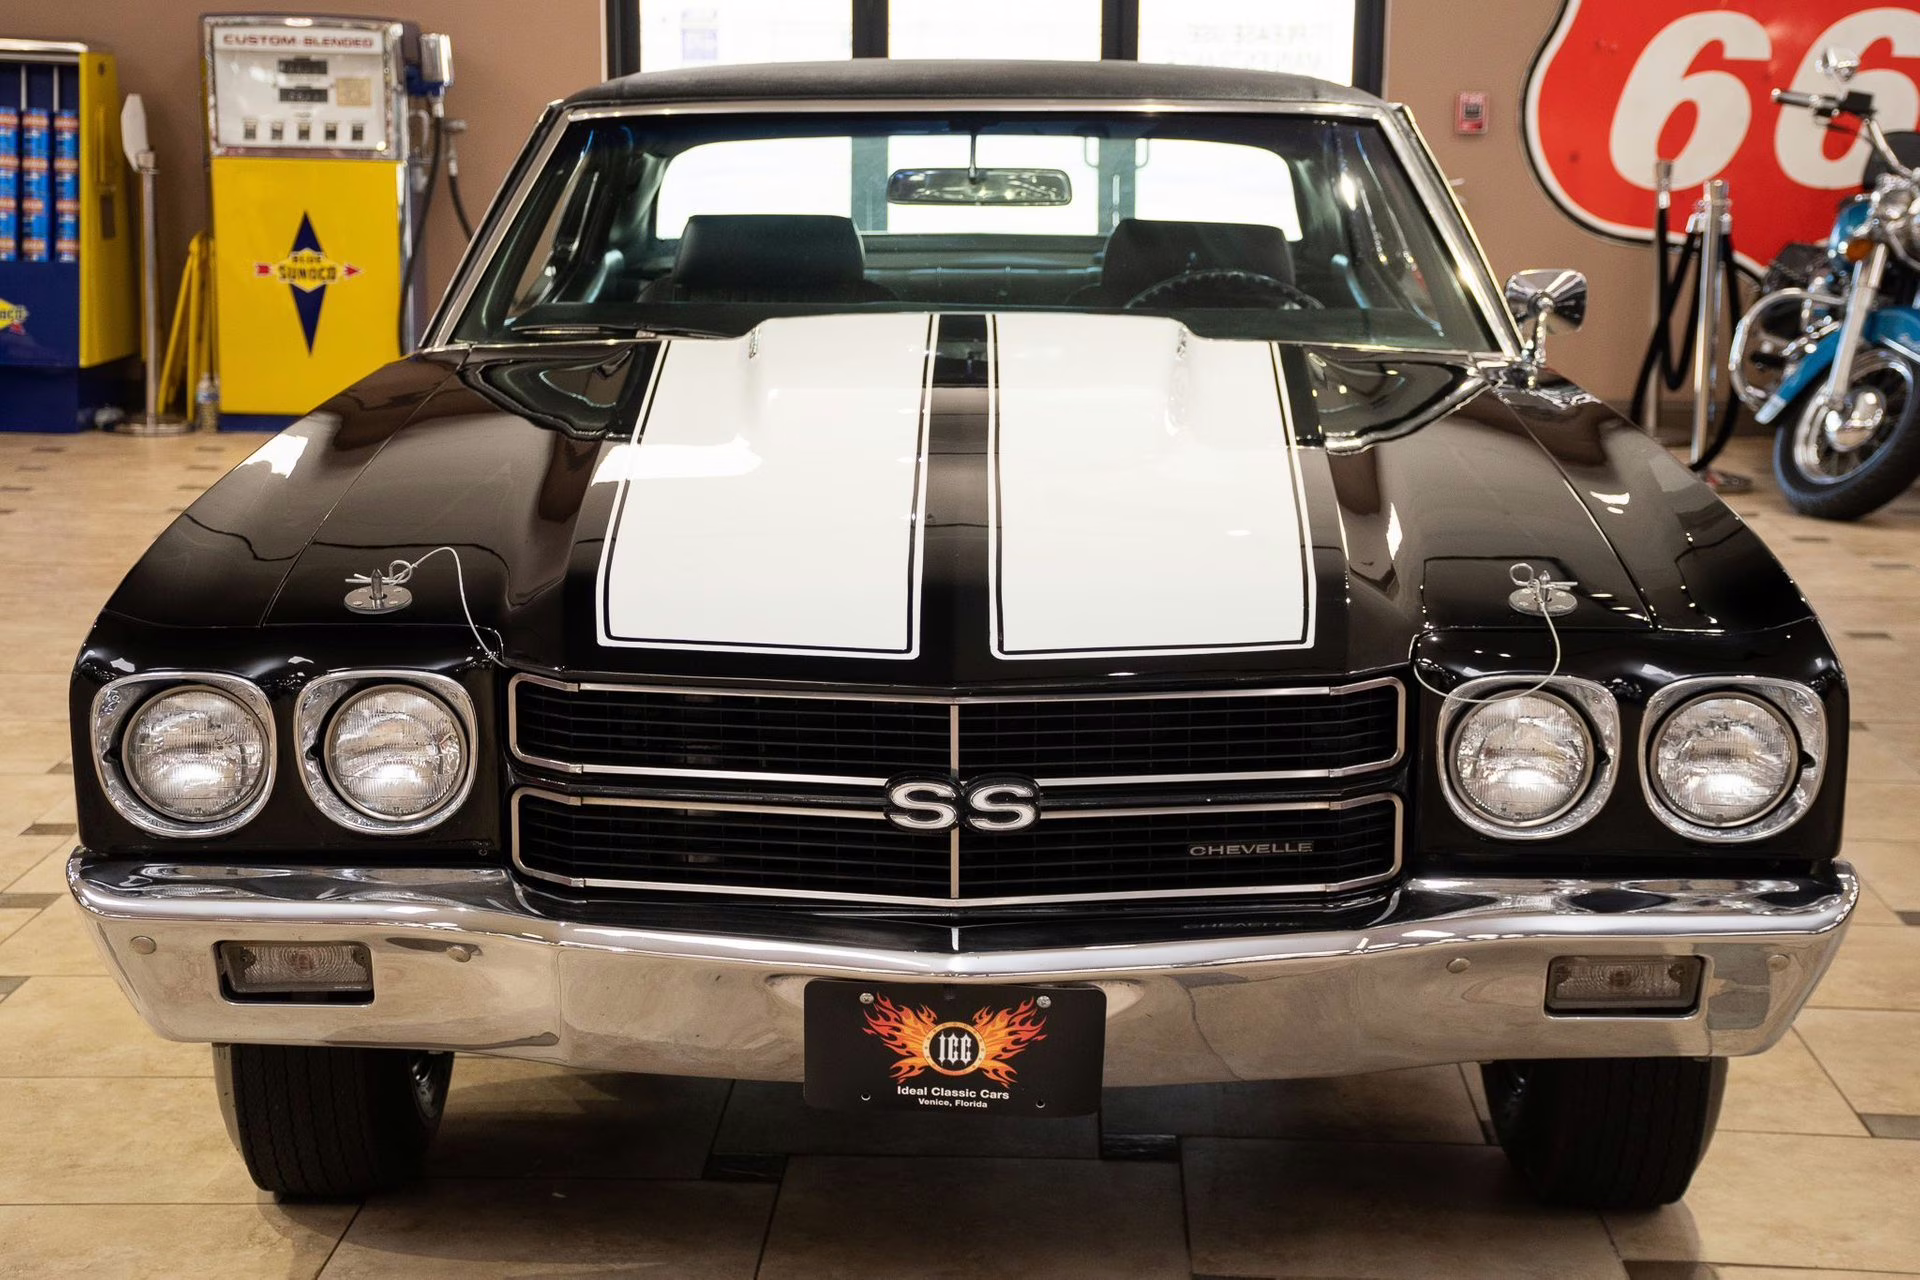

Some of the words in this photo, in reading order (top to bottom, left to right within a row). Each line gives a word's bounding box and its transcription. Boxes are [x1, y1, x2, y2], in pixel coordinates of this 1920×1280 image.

[223, 34, 296, 46] CUSTOM
[303, 36, 374, 48] BLENDED
[1609, 7, 1920, 190] 66
[279, 265, 336, 280] SUNOCO
[889, 781, 1037, 832] SS
[1189, 842, 1313, 856] CHEVELLE
[897, 1086, 928, 1096] Ideal
[931, 1087, 977, 1098] Classic
[980, 1089, 1010, 1100] Cars
[918, 1098, 953, 1107] Venice,
[955, 1099, 988, 1108] Florida
